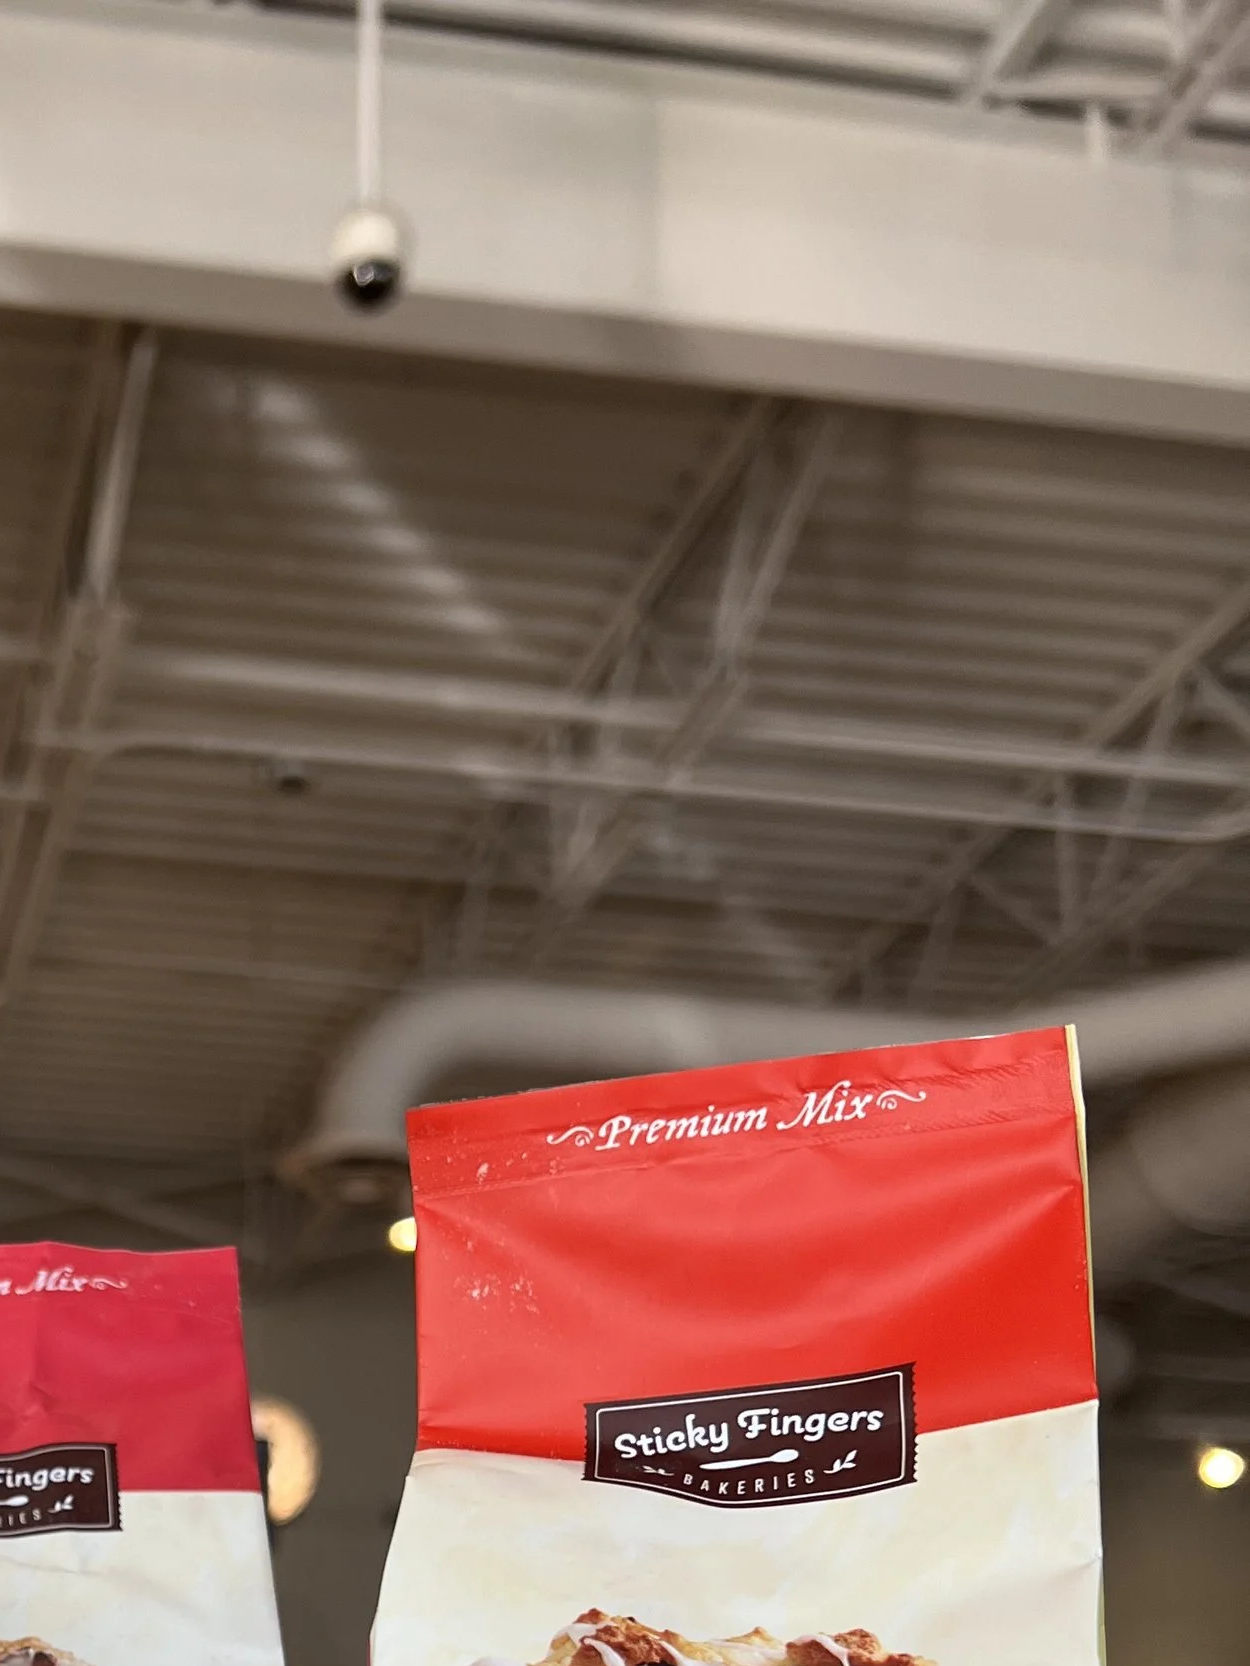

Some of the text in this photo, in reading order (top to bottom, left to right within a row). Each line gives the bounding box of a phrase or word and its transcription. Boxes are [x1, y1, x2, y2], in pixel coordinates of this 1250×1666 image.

[595, 1080, 874, 1151] Premium Mix
[15, 1266, 88, 1295] Mix
[614, 1408, 884, 1459] Sticky Fingers
[683, 1469, 815, 1495] BAKERIES
